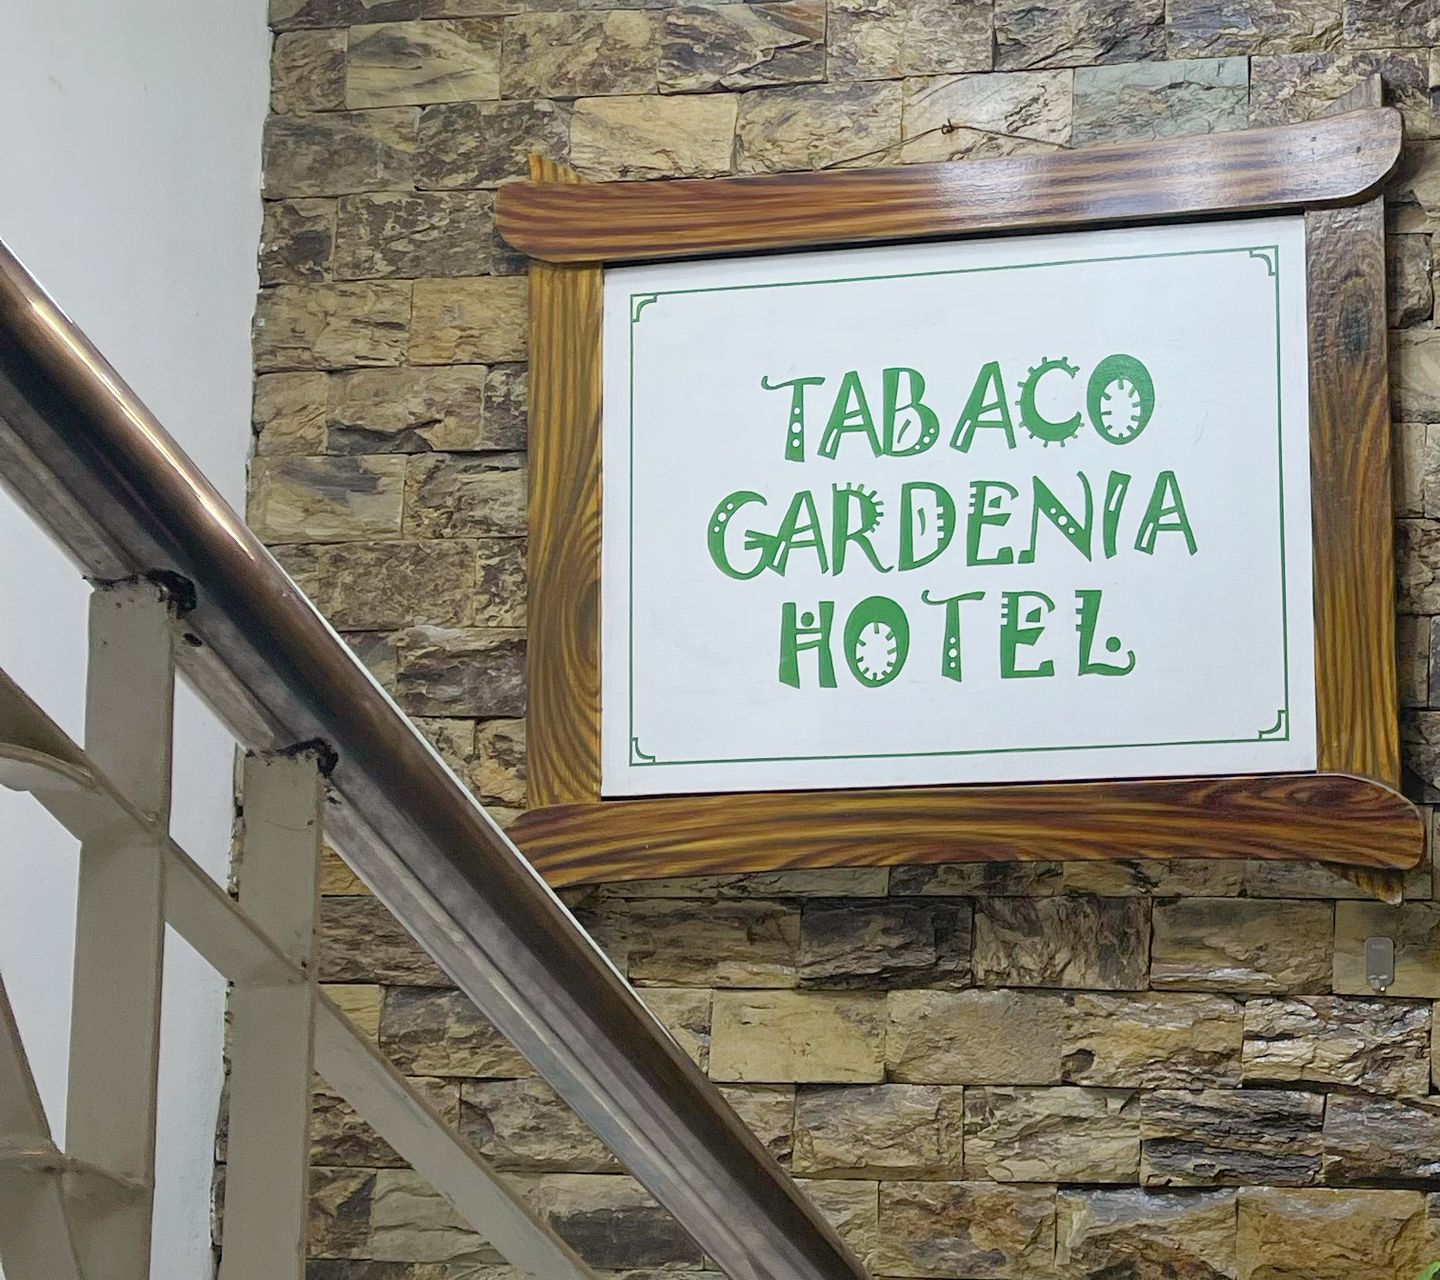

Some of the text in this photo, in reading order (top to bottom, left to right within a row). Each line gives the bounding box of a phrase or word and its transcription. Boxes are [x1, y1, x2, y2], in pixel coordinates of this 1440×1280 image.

[761, 354, 1155, 462] TABACO
[707, 470, 1198, 580] GARDENIA
[779, 589, 1136, 689] HOTEL
